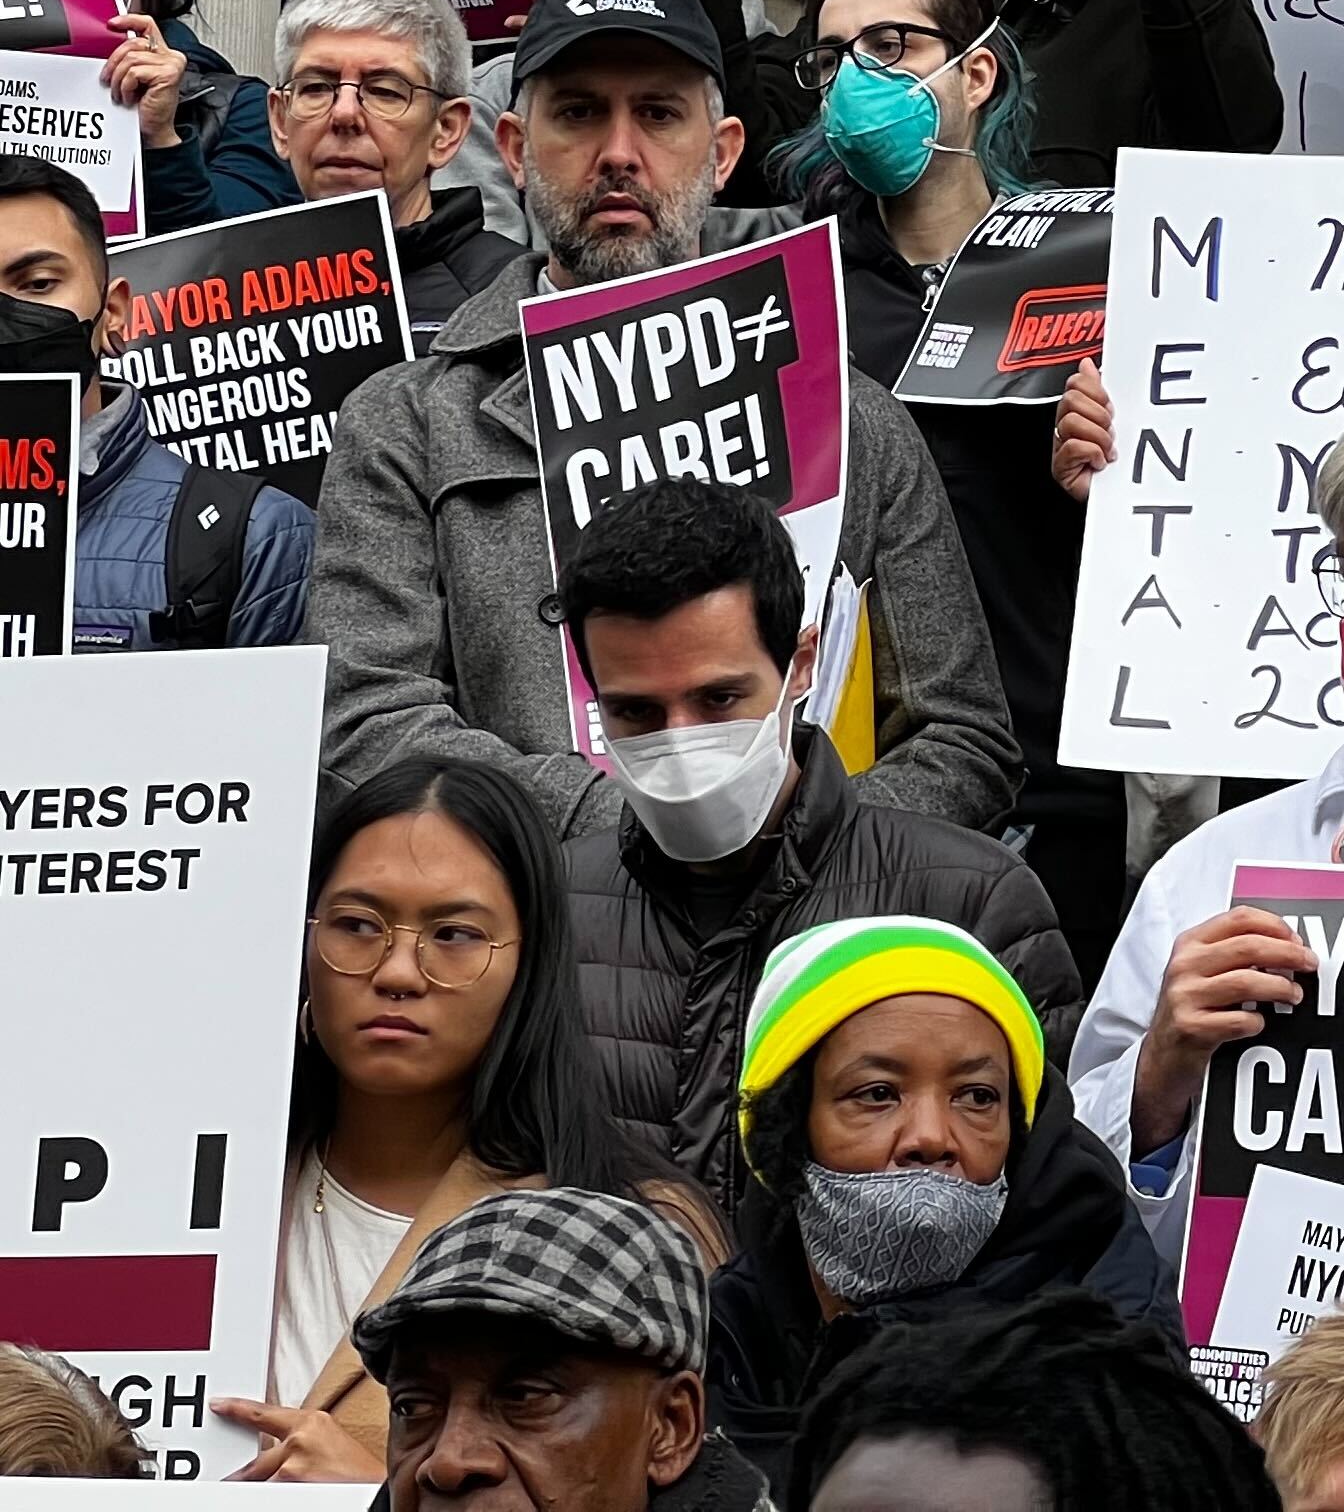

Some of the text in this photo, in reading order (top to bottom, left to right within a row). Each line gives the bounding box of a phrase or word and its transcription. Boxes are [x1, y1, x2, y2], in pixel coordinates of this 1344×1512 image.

[974, 215, 1055, 248] PLAN!
[1153, 216, 1222, 302] M
[243, 247, 390, 314] ADAMS,
[191, 304, 383, 376] BACK YOUR
[1150, 342, 1207, 406] E
[1135, 428, 1191, 486] N
[1133, 505, 1193, 555] T
[1122, 574, 1182, 629] A
[144, 781, 250, 825] FOR
[1190, 1360, 1233, 1377] UNITED
